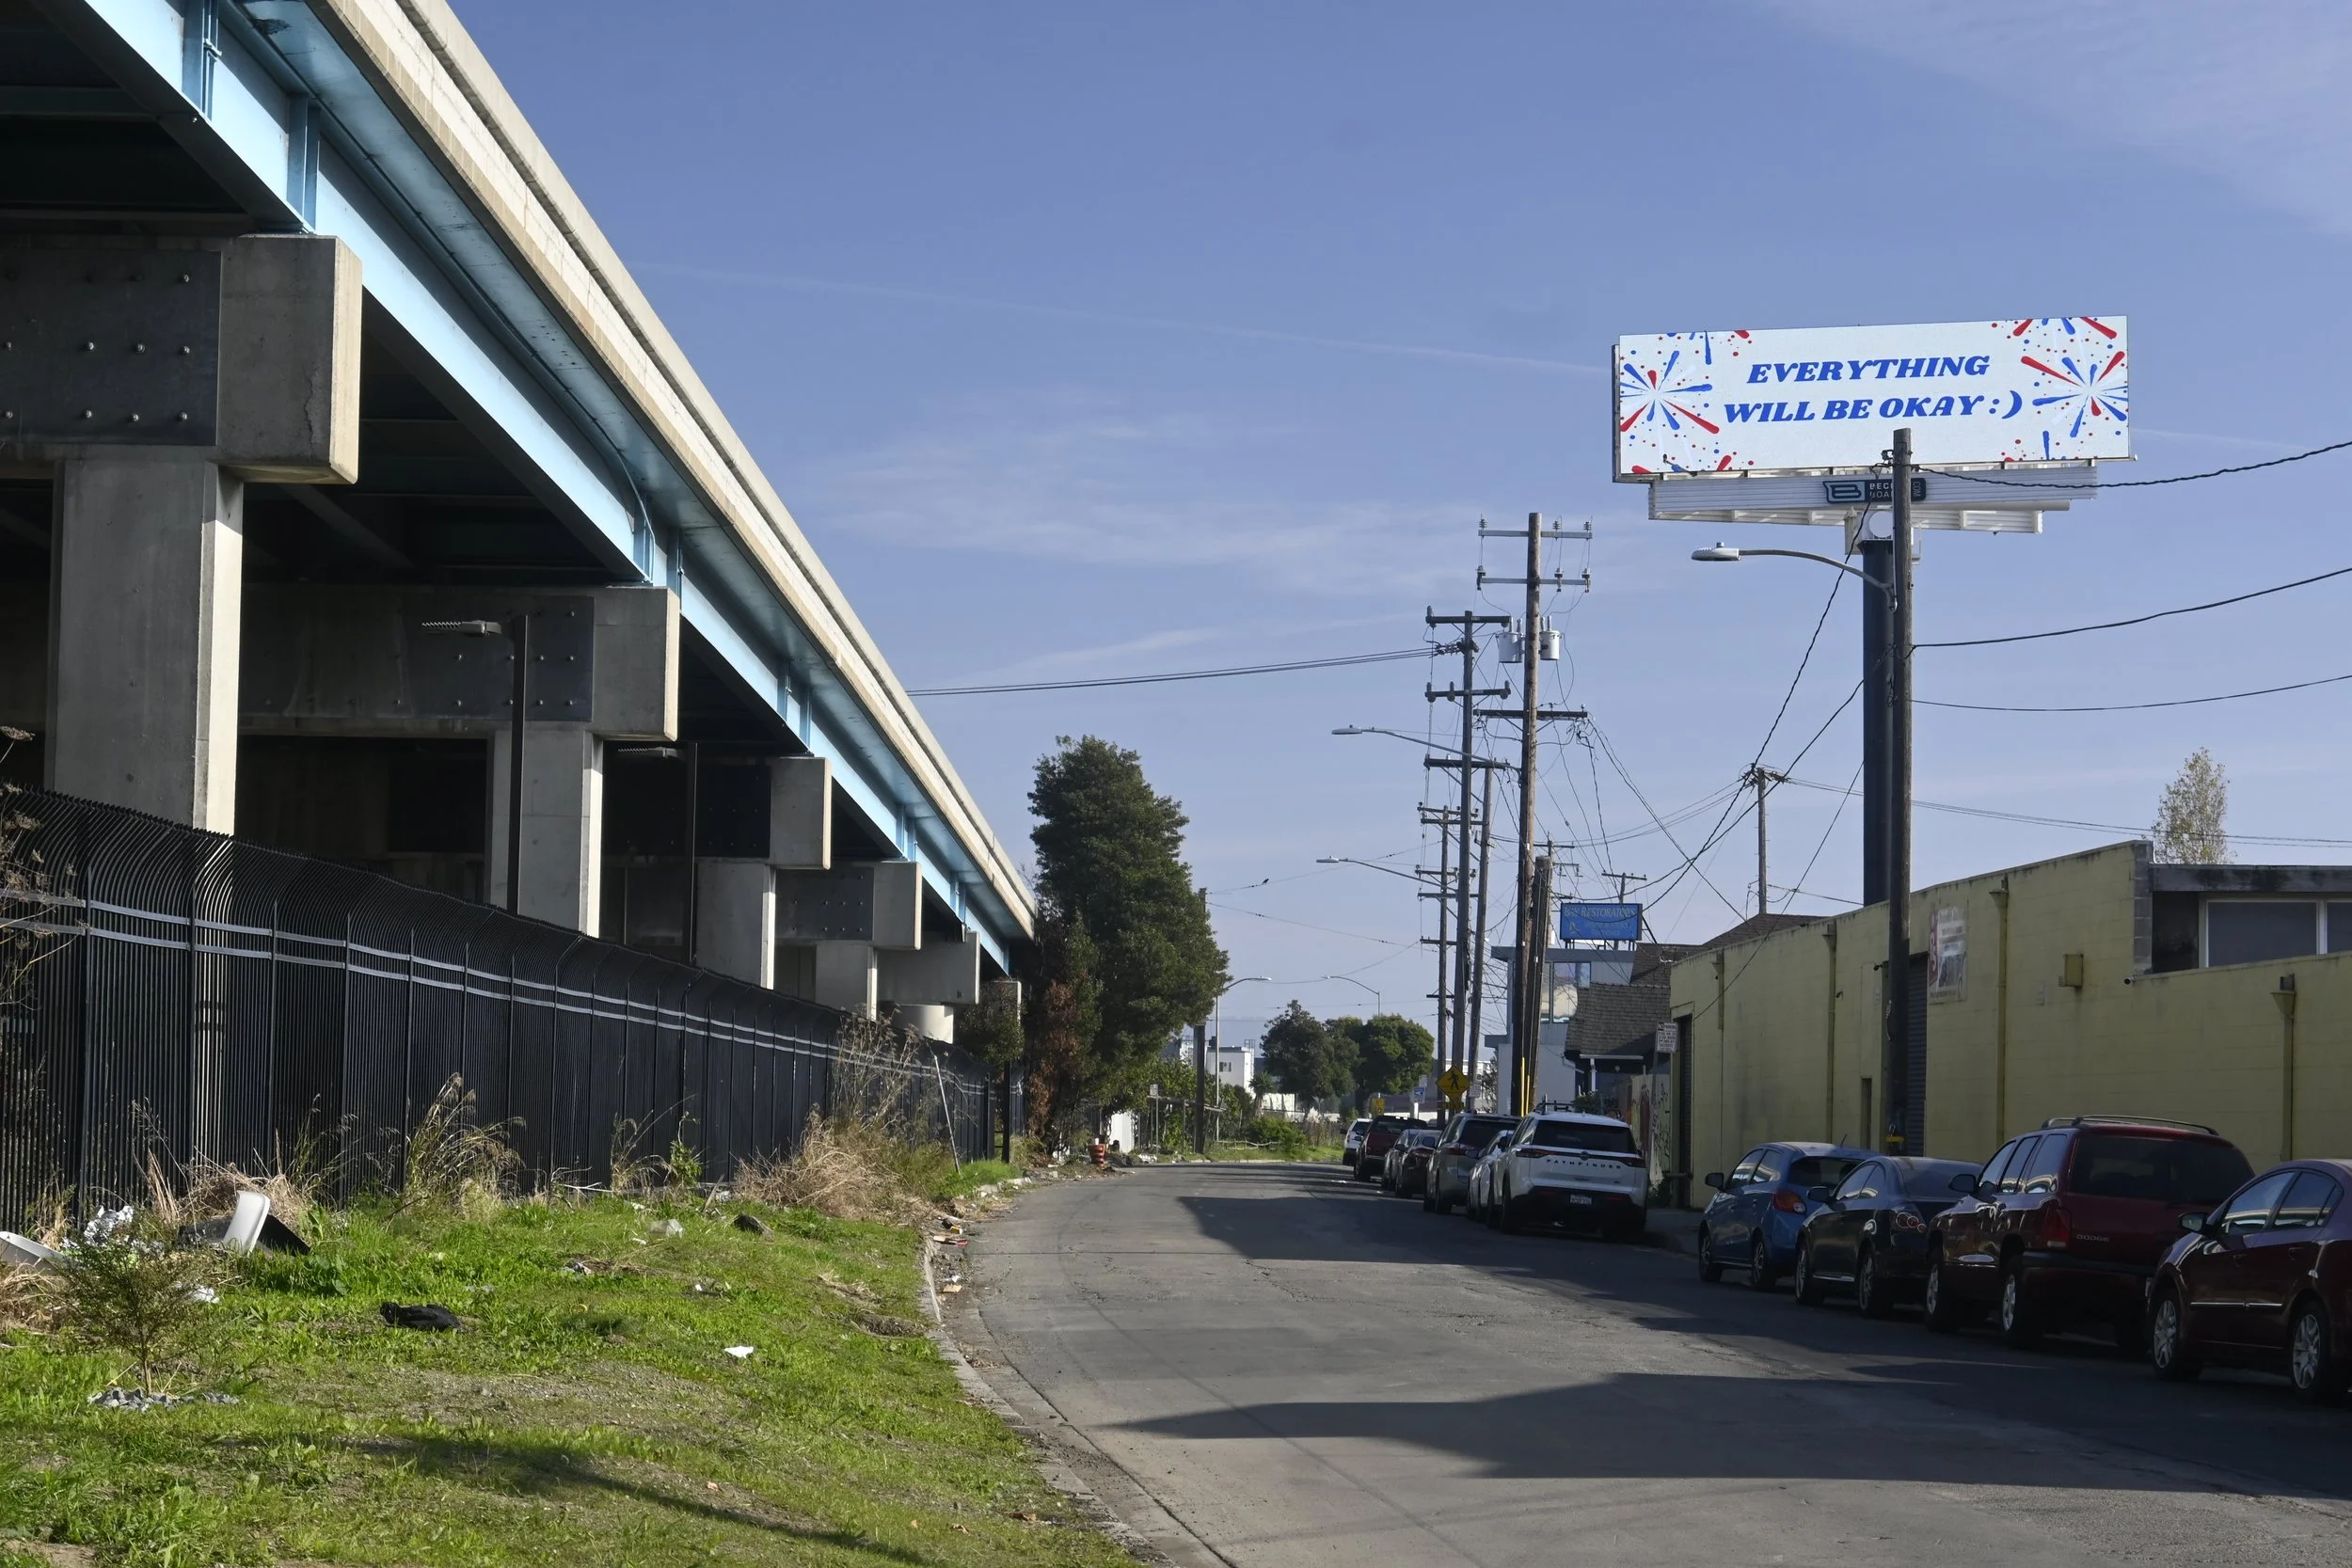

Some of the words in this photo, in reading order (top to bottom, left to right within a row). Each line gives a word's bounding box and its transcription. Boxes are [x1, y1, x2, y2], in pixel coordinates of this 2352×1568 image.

[1747, 356, 1990, 384] EVERYTHING
[1724, 402, 1815, 422] WILL
[1822, 399, 1873, 420] BE
[1879, 395, 1984, 418] OKAY
[1546, 1159, 1621, 1169] PATHFINDER
[2076, 1234, 2110, 1243] DODGE
